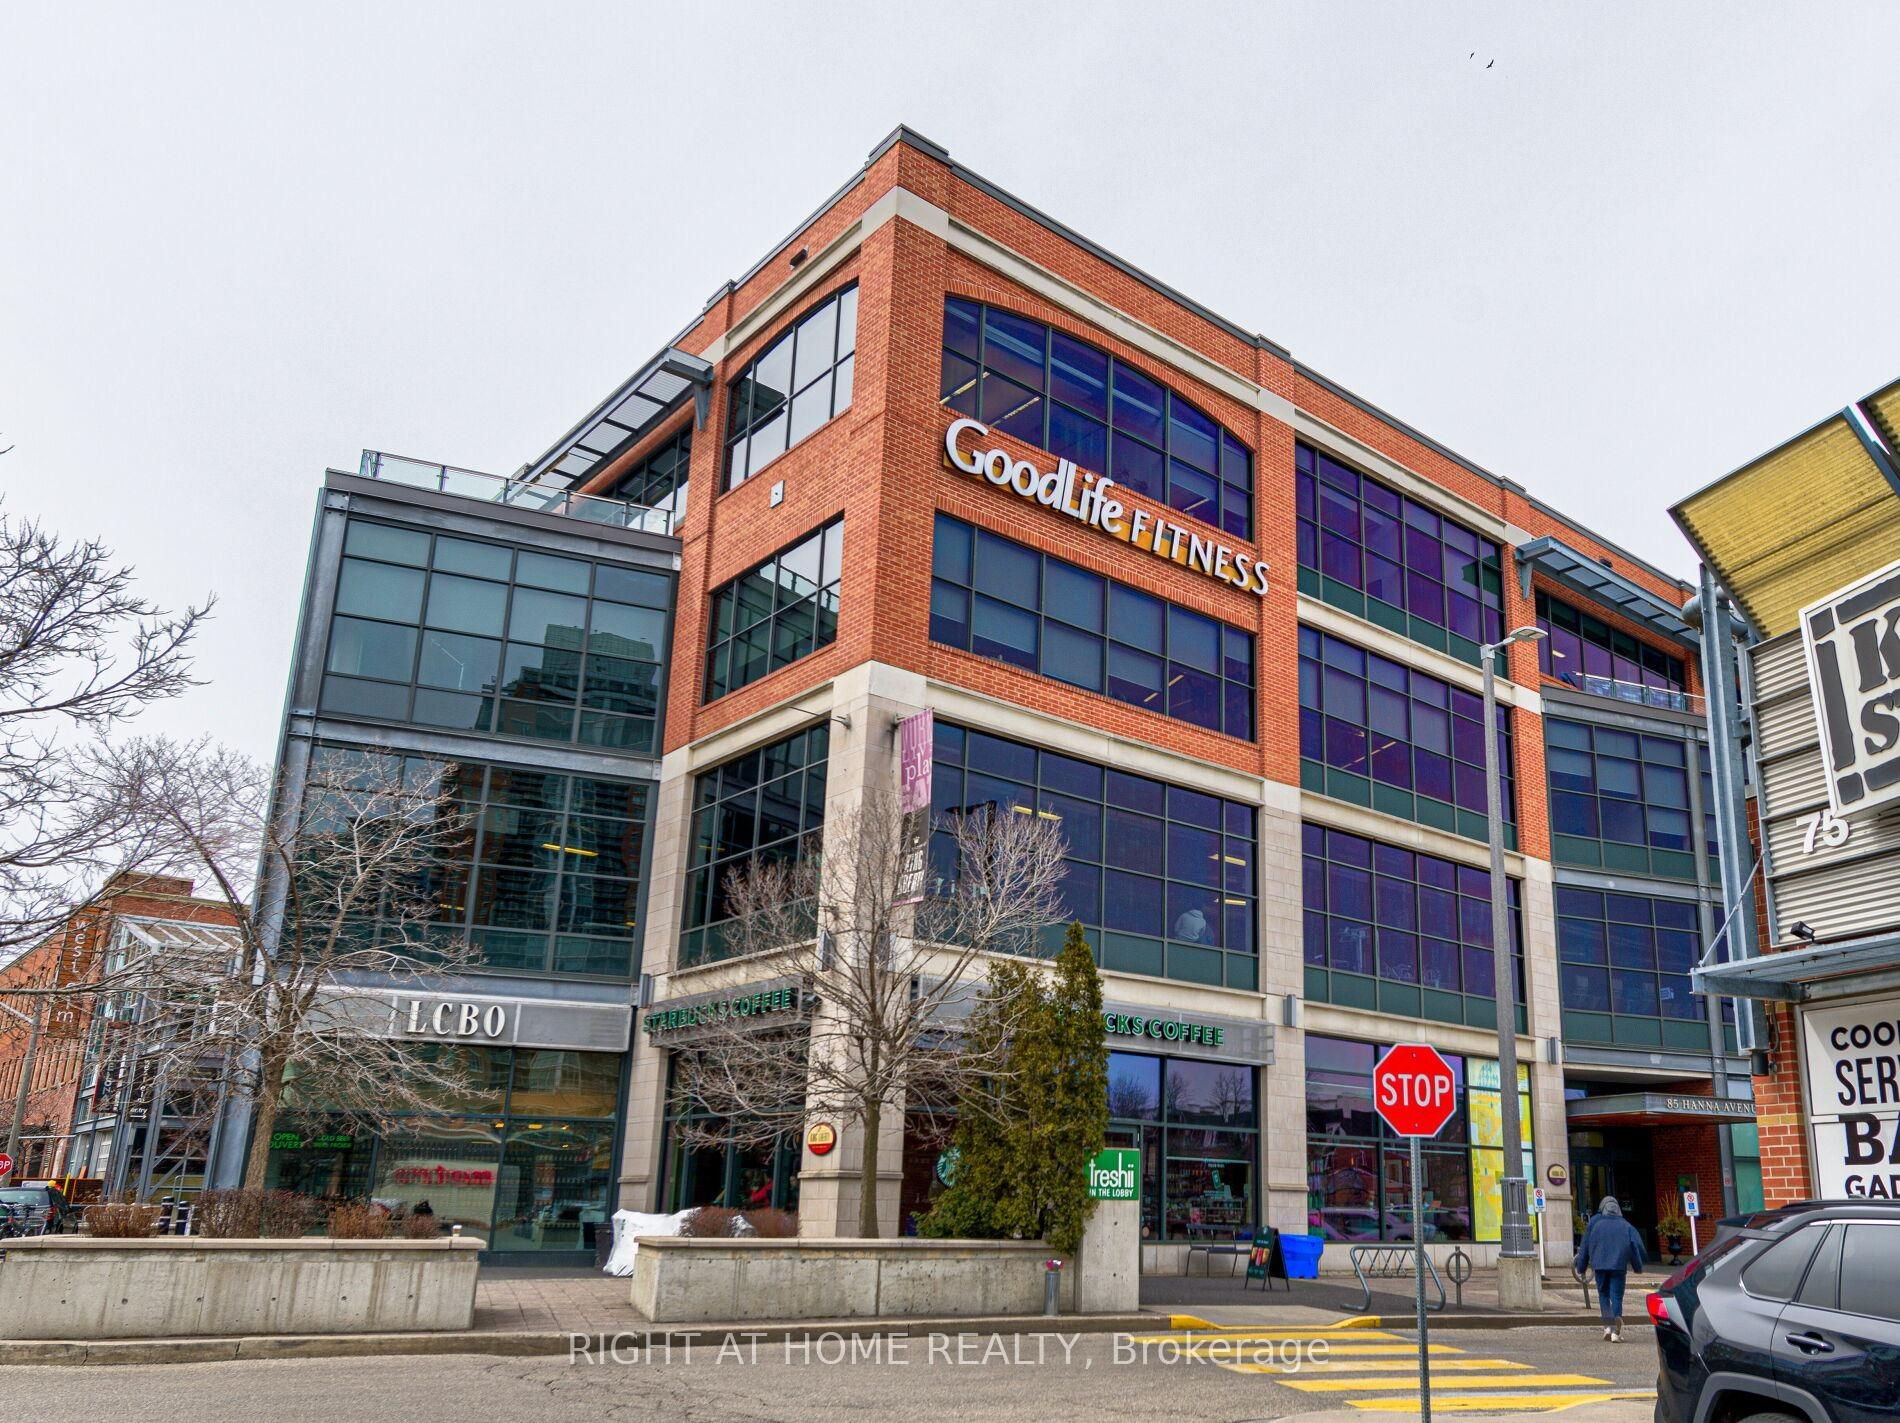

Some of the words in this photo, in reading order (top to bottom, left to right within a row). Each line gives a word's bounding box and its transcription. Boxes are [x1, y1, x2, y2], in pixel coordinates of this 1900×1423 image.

[945, 418, 1124, 533] GoodLife
[1130, 508, 1271, 596] FITNESS
[1860, 689, 1900, 756] S
[1796, 811, 1849, 855] 75
[405, 1000, 506, 1038] LCBO
[731, 987, 793, 1018] COFFEE
[1103, 1012, 1144, 1036] CKS
[1148, 1019, 1225, 1047] COFFEE
[1831, 1020, 1900, 1051] COO
[1381, 1072, 1451, 1107] STOP
[1835, 1055, 1900, 1107] SER
[1666, 1098, 1679, 1109] 85
[1682, 1099, 1720, 1112] HANNA
[1088, 1151, 1134, 1188] freshii
[1098, 1188, 1110, 1197] THE
[1112, 1188, 1133, 1198] LOBBY
